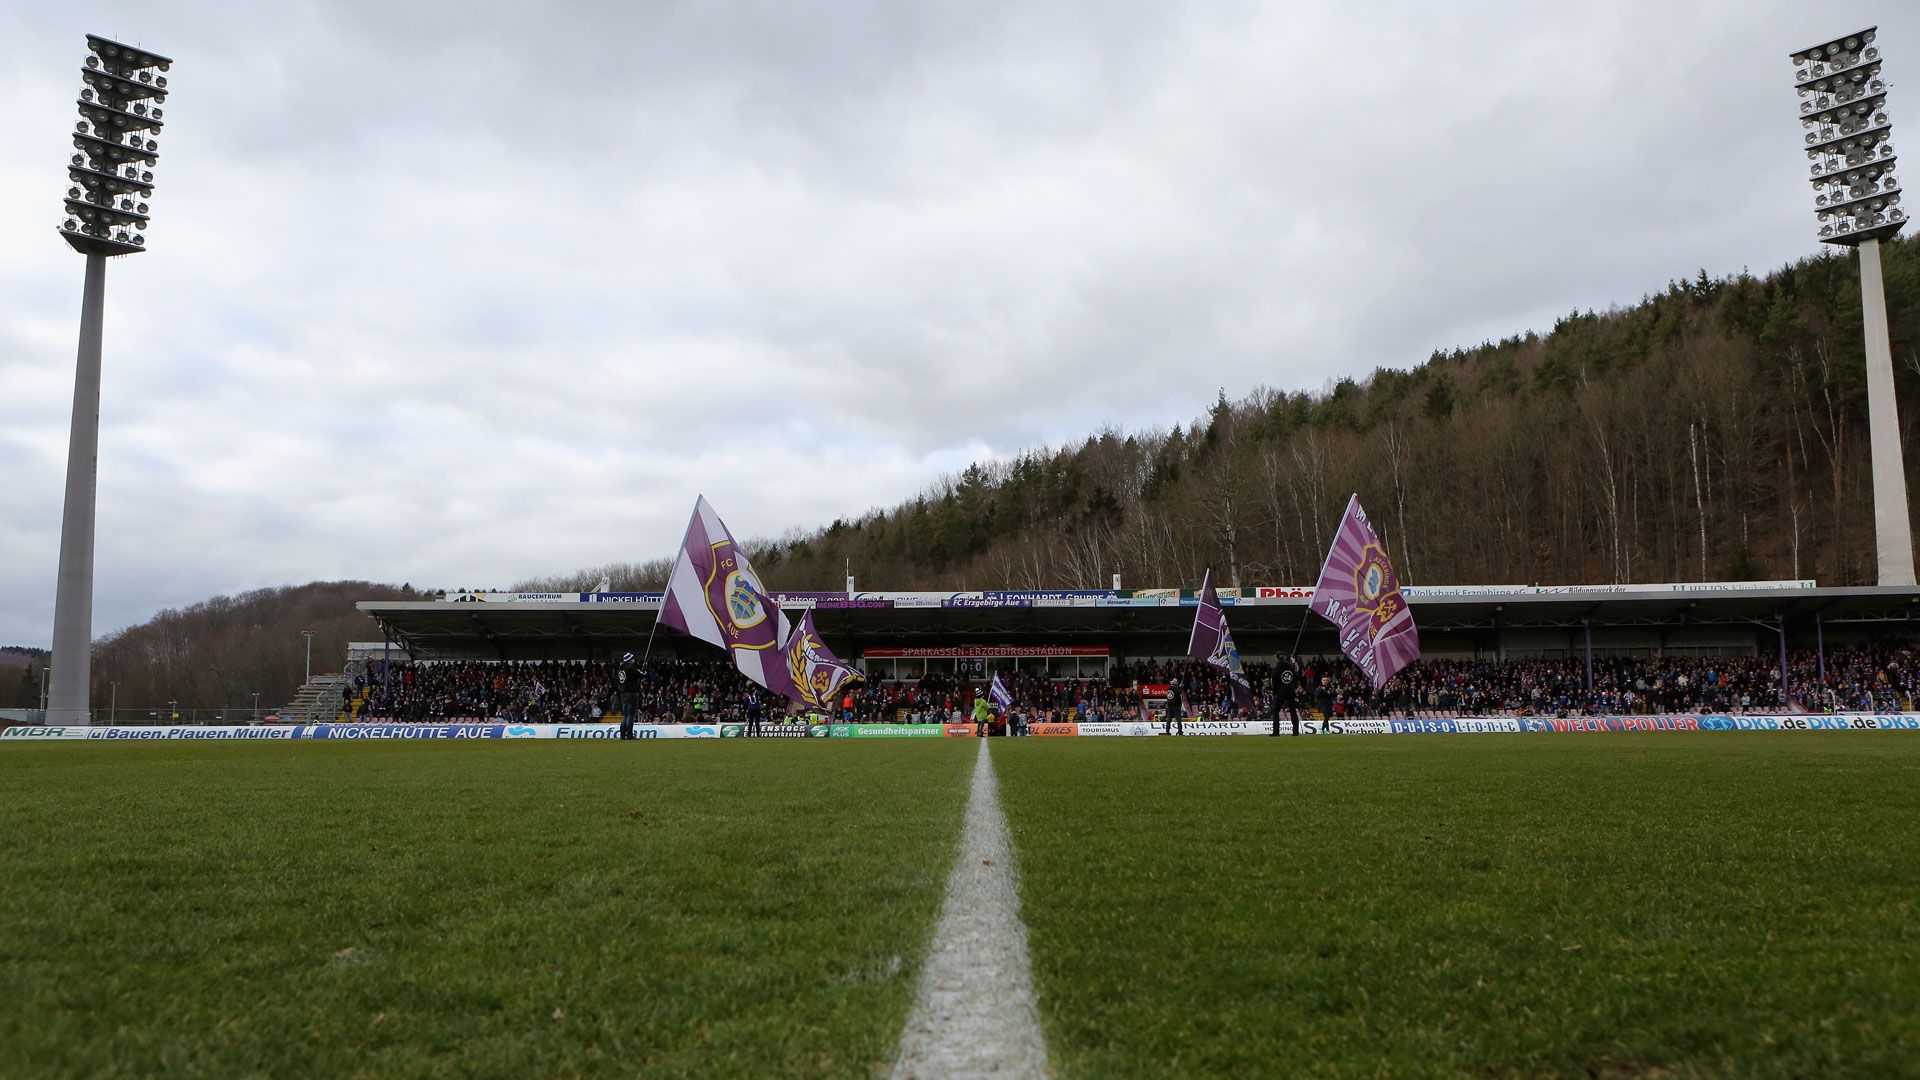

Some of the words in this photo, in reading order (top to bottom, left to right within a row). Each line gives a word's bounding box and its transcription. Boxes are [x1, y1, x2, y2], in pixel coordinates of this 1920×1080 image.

[720, 558, 733, 570] FC
[963, 599, 1003, 608] Erzgebirge
[726, 622, 740, 639] AUE
[1550, 718, 1611, 732] WECK
[1620, 718, 1700, 731] POLLER
[1738, 717, 1806, 730] DKB.de
[1808, 717, 1877, 730] DKB.de
[4, 728, 66, 736] MBR
[327, 726, 450, 739] NICKELHÜTTE
[454, 727, 493, 739] AUE
[857, 727, 939, 737] Gesundheitspartner
[1043, 726, 1073, 735] BIKES
